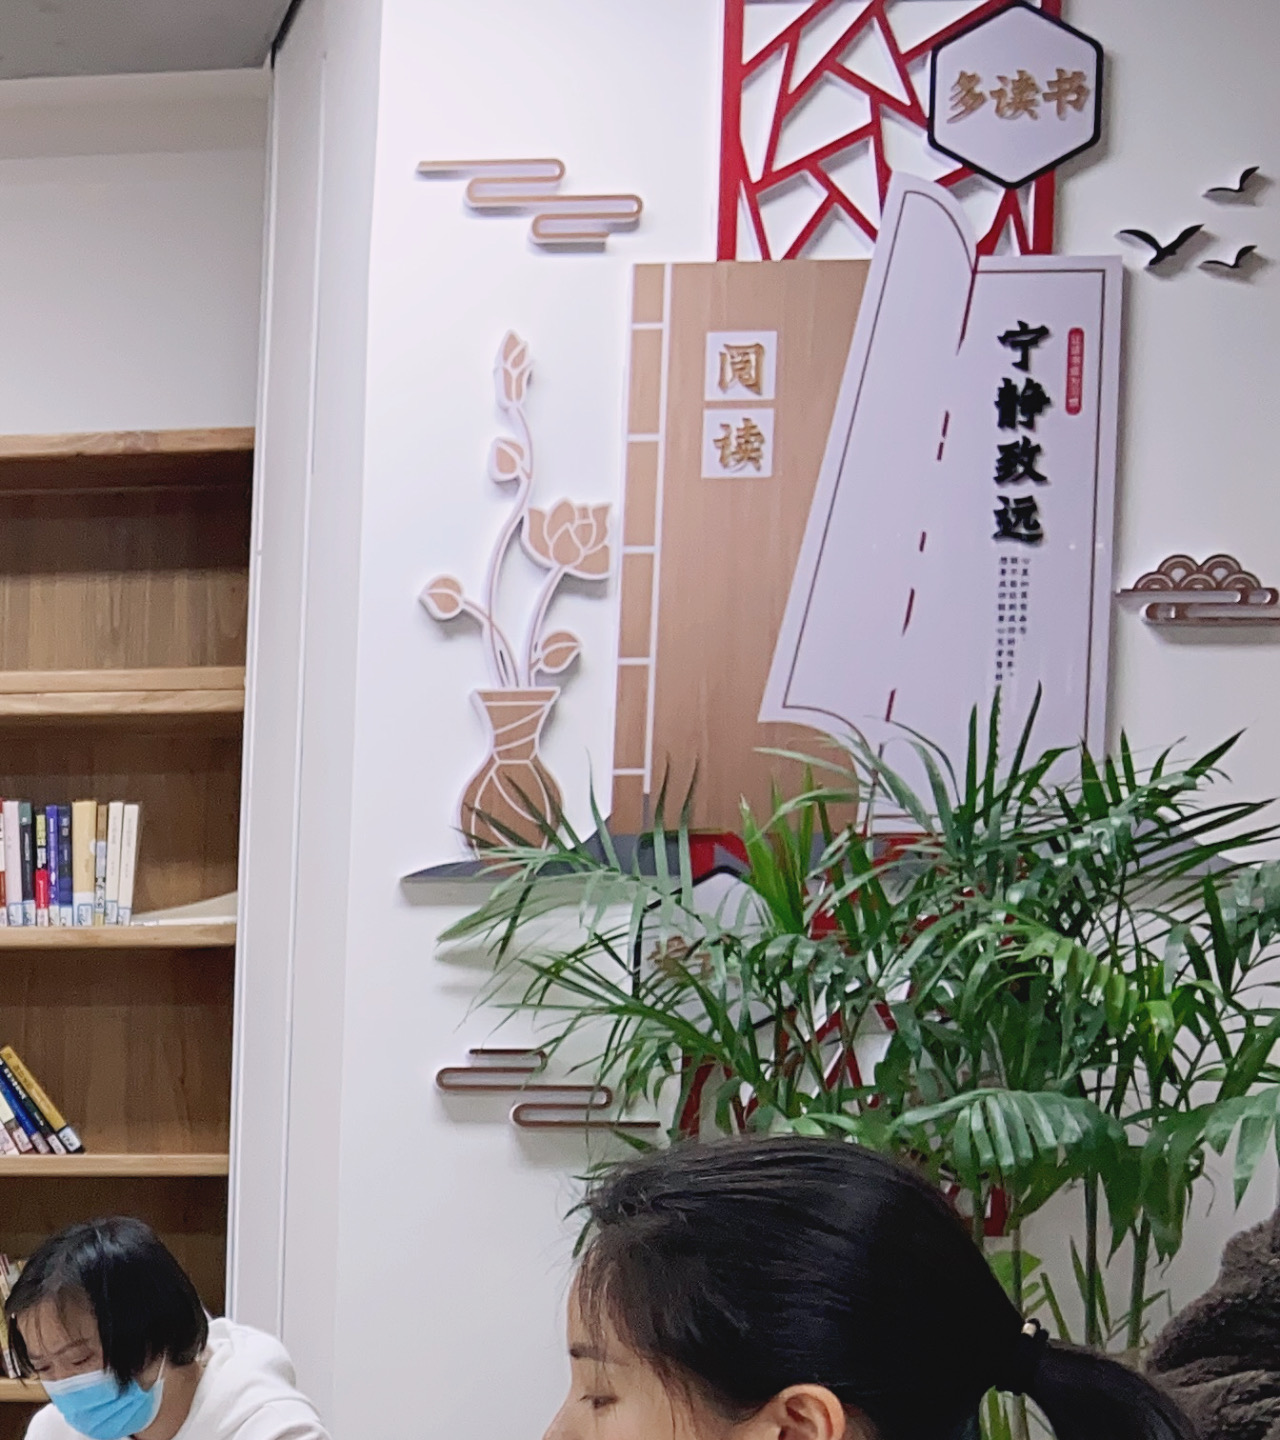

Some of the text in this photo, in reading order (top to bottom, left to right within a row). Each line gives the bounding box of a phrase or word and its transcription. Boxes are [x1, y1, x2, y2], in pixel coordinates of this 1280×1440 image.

[946, 67, 1090, 124] 多读书
[992, 320, 1051, 545] 宁静致远
